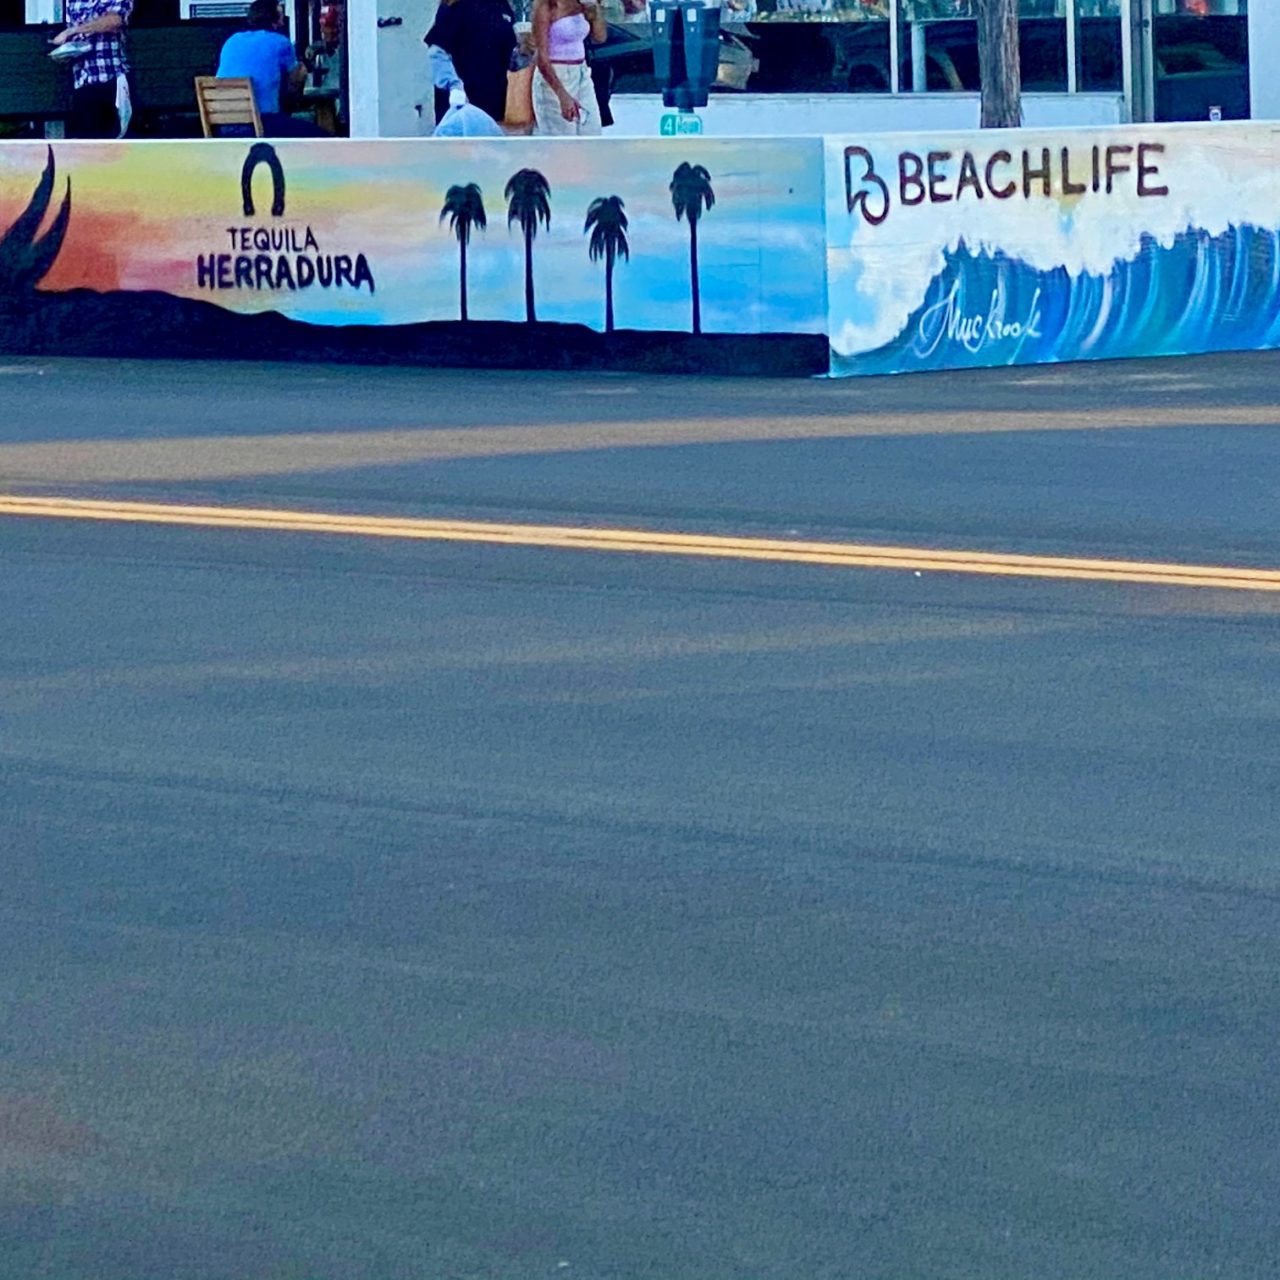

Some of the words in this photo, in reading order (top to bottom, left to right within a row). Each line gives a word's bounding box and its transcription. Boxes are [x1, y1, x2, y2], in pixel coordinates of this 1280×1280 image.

[898, 143, 1169, 206] BEACHLIFE
[227, 226, 320, 253] TEQUILA
[197, 252, 376, 296] HERRADURA
